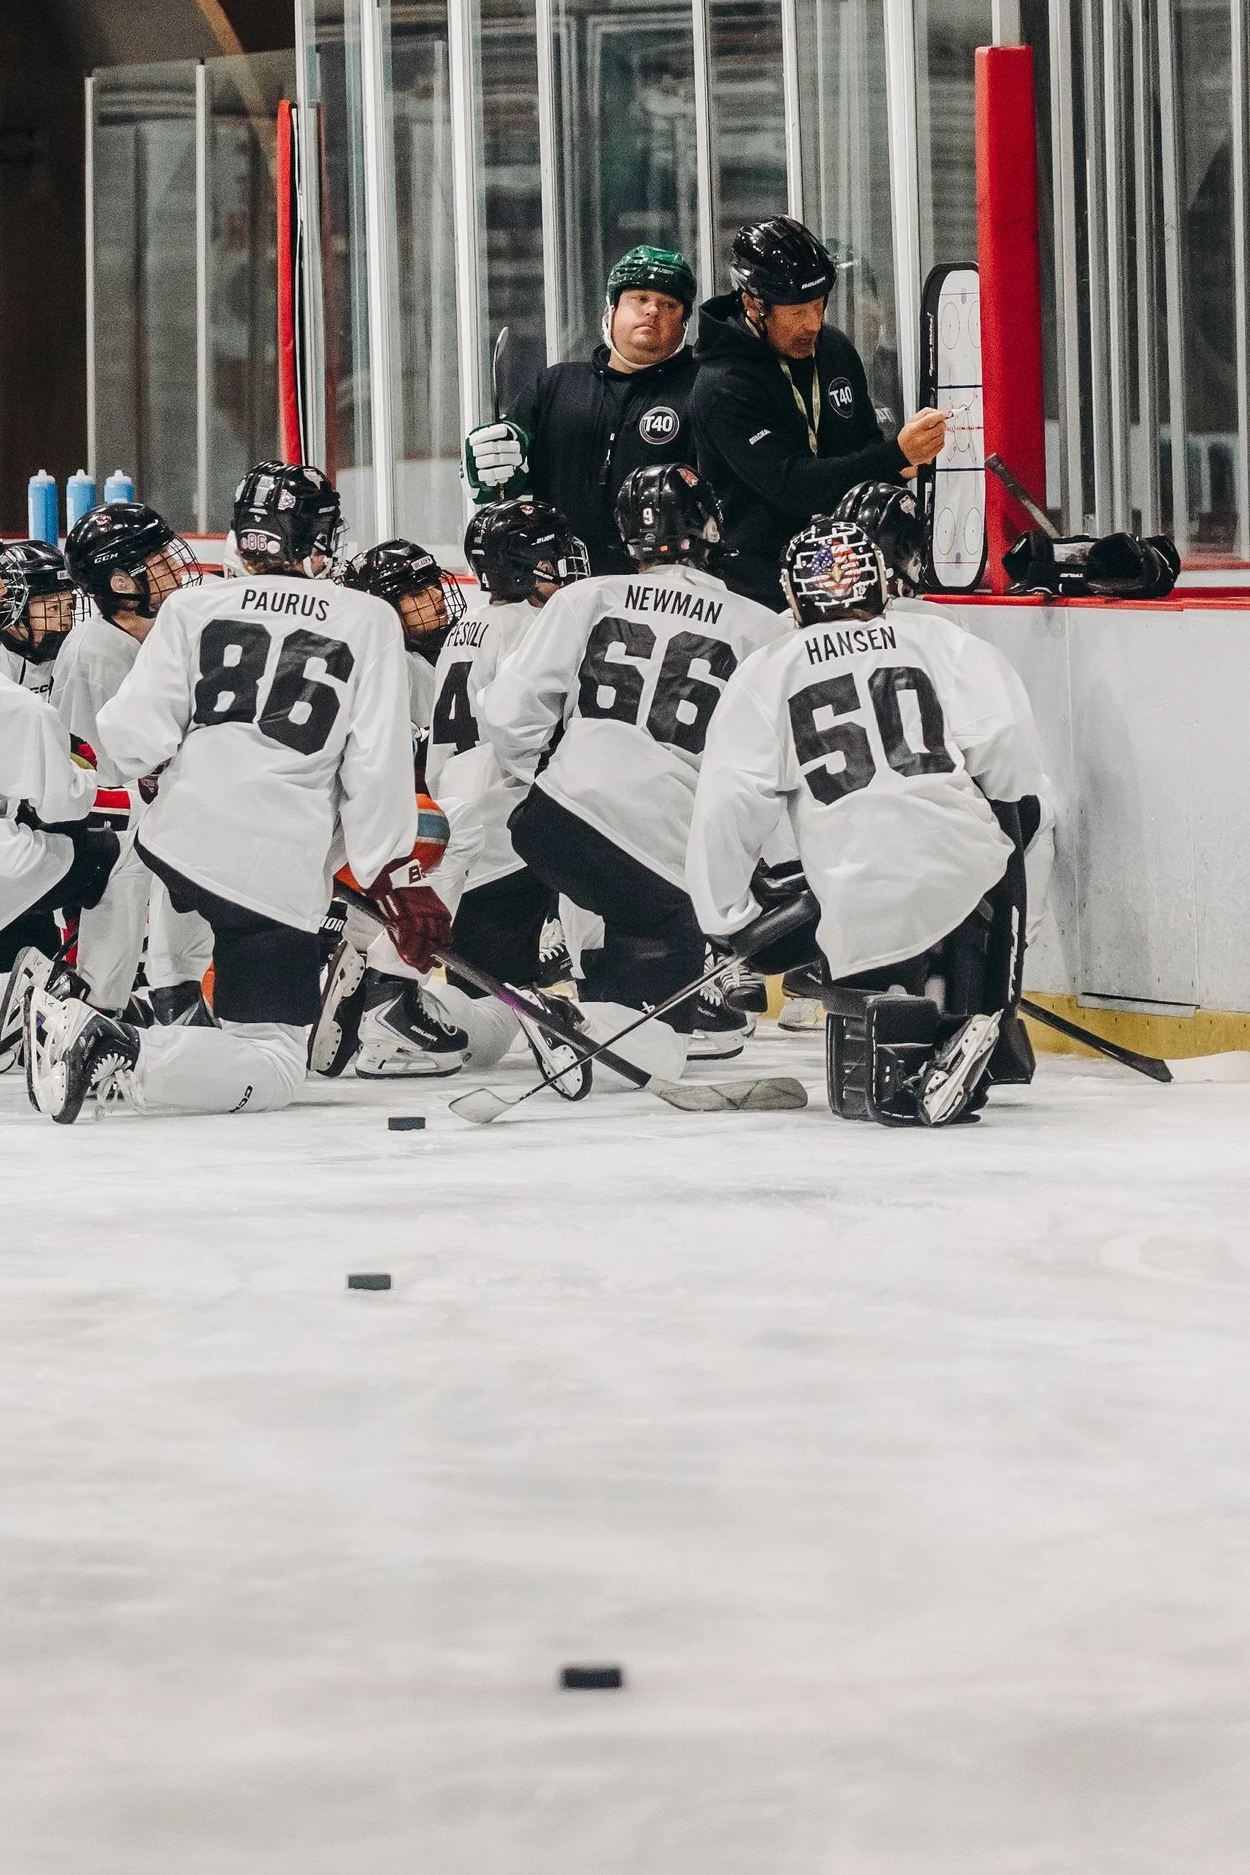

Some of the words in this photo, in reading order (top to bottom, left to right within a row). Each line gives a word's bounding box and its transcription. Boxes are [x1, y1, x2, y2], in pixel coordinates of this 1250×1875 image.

[830, 387, 851, 406] T40
[644, 414, 672, 432] T40
[642, 508, 655, 525] 9
[94, 552, 119, 564] CCM
[481, 572, 490, 589] 4
[241, 589, 329, 621] PAURUS
[625, 584, 723, 625] NEWMAN
[805, 626, 897, 665] HANSEN
[193, 619, 355, 756] 86
[578, 616, 738, 755] 66
[787, 666, 957, 806] 50
